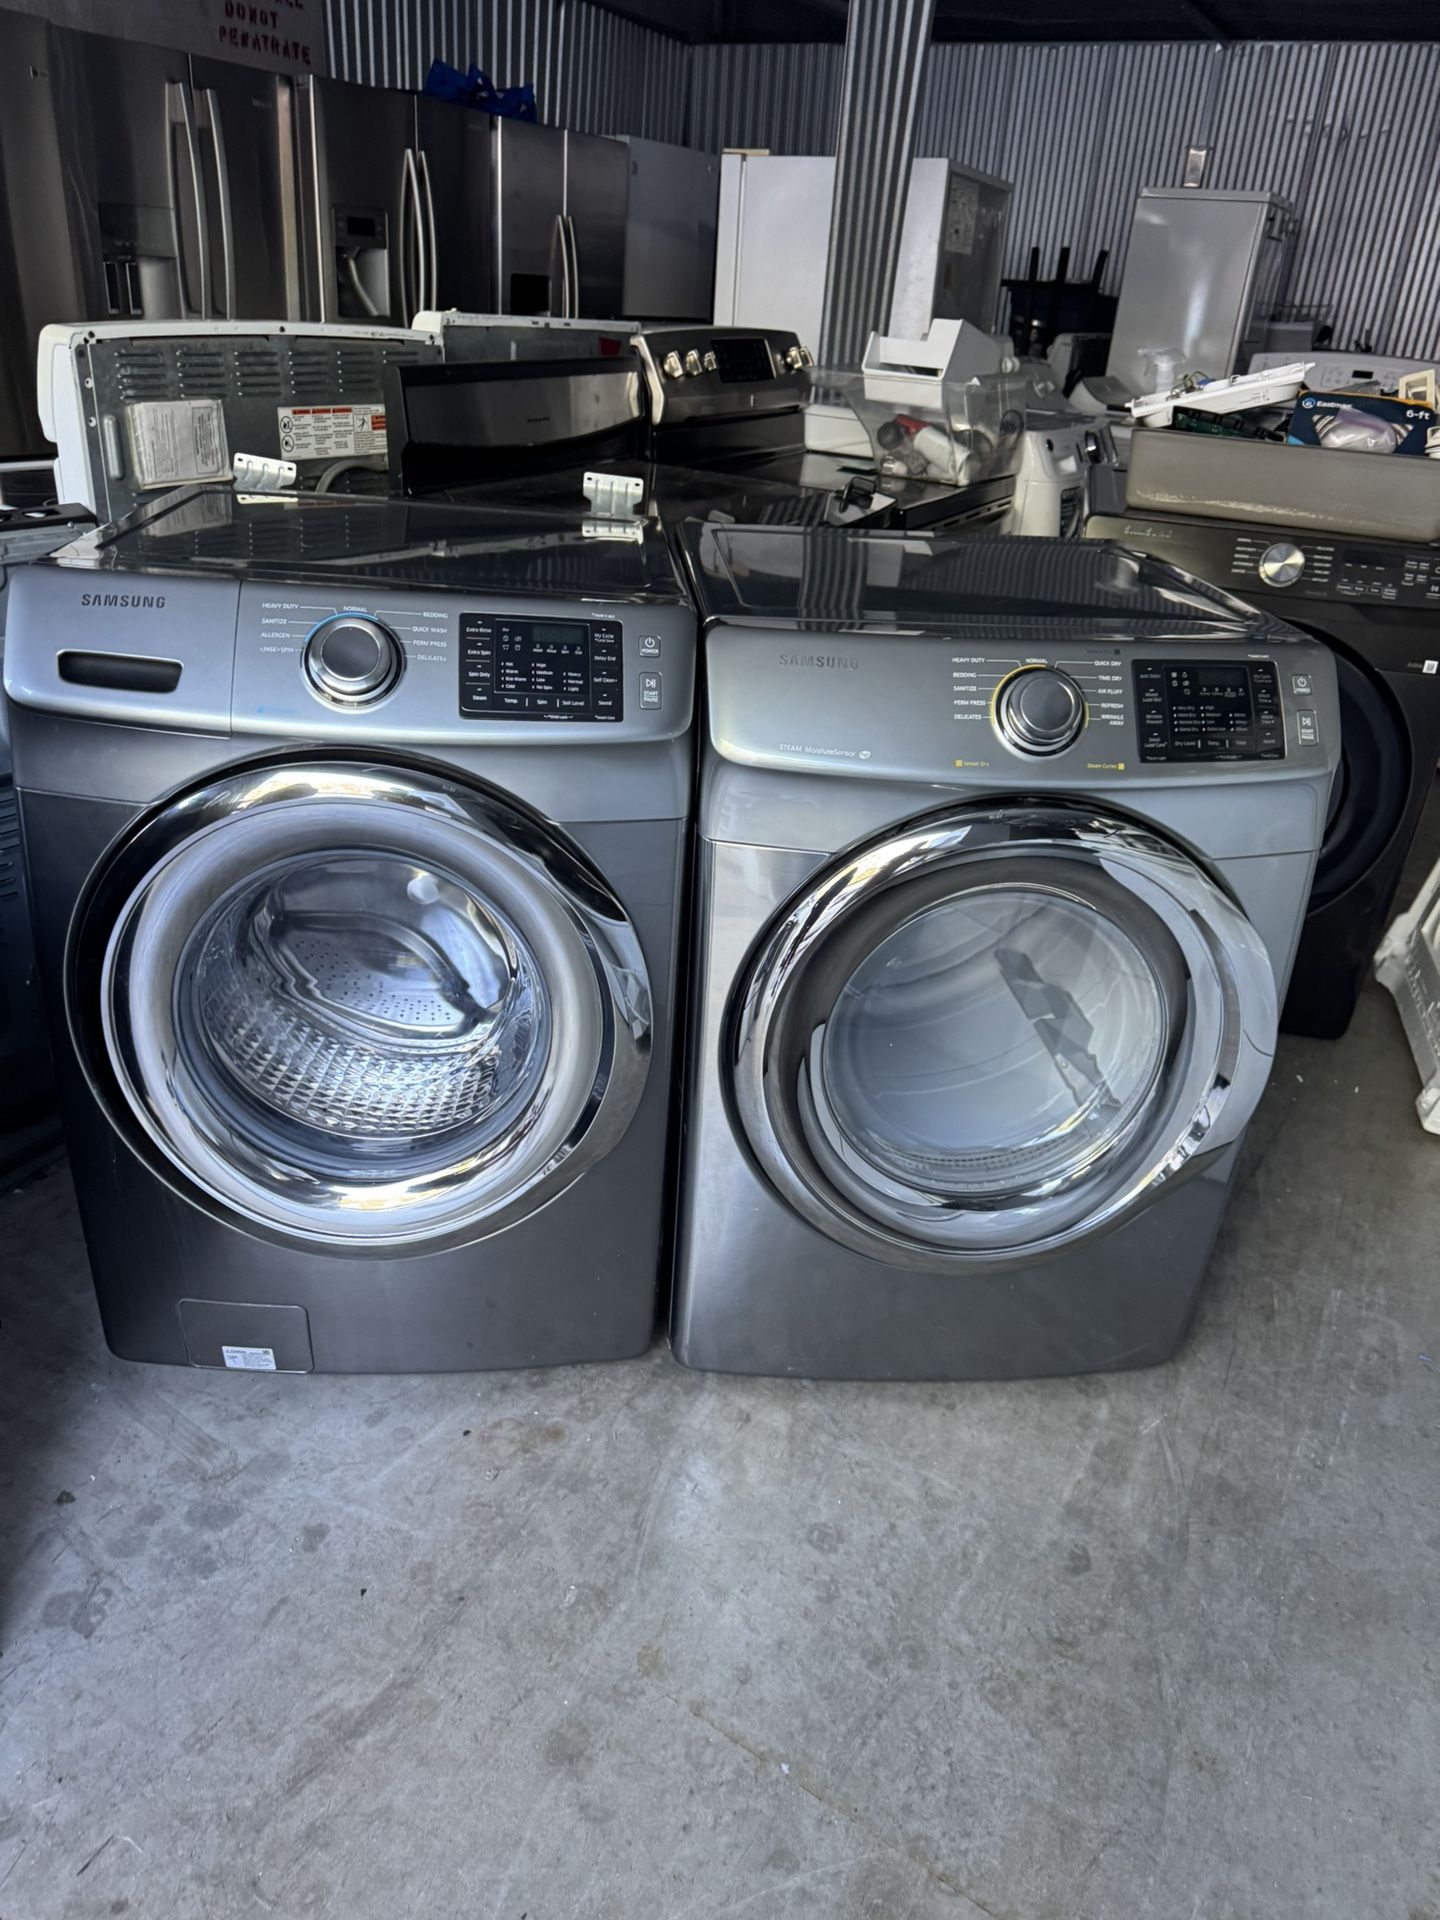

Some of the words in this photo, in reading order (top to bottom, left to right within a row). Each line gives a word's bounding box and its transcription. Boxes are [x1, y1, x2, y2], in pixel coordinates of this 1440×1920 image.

[1406, 409, 1431, 420] 6-ft
[81, 594, 166, 608] SAMSUNG
[779, 654, 859, 670] SAMSUNG
[780, 744, 803, 752] STEAM
[805, 746, 857, 757] MoistureSensor
[980, 761, 990, 769] Dry
